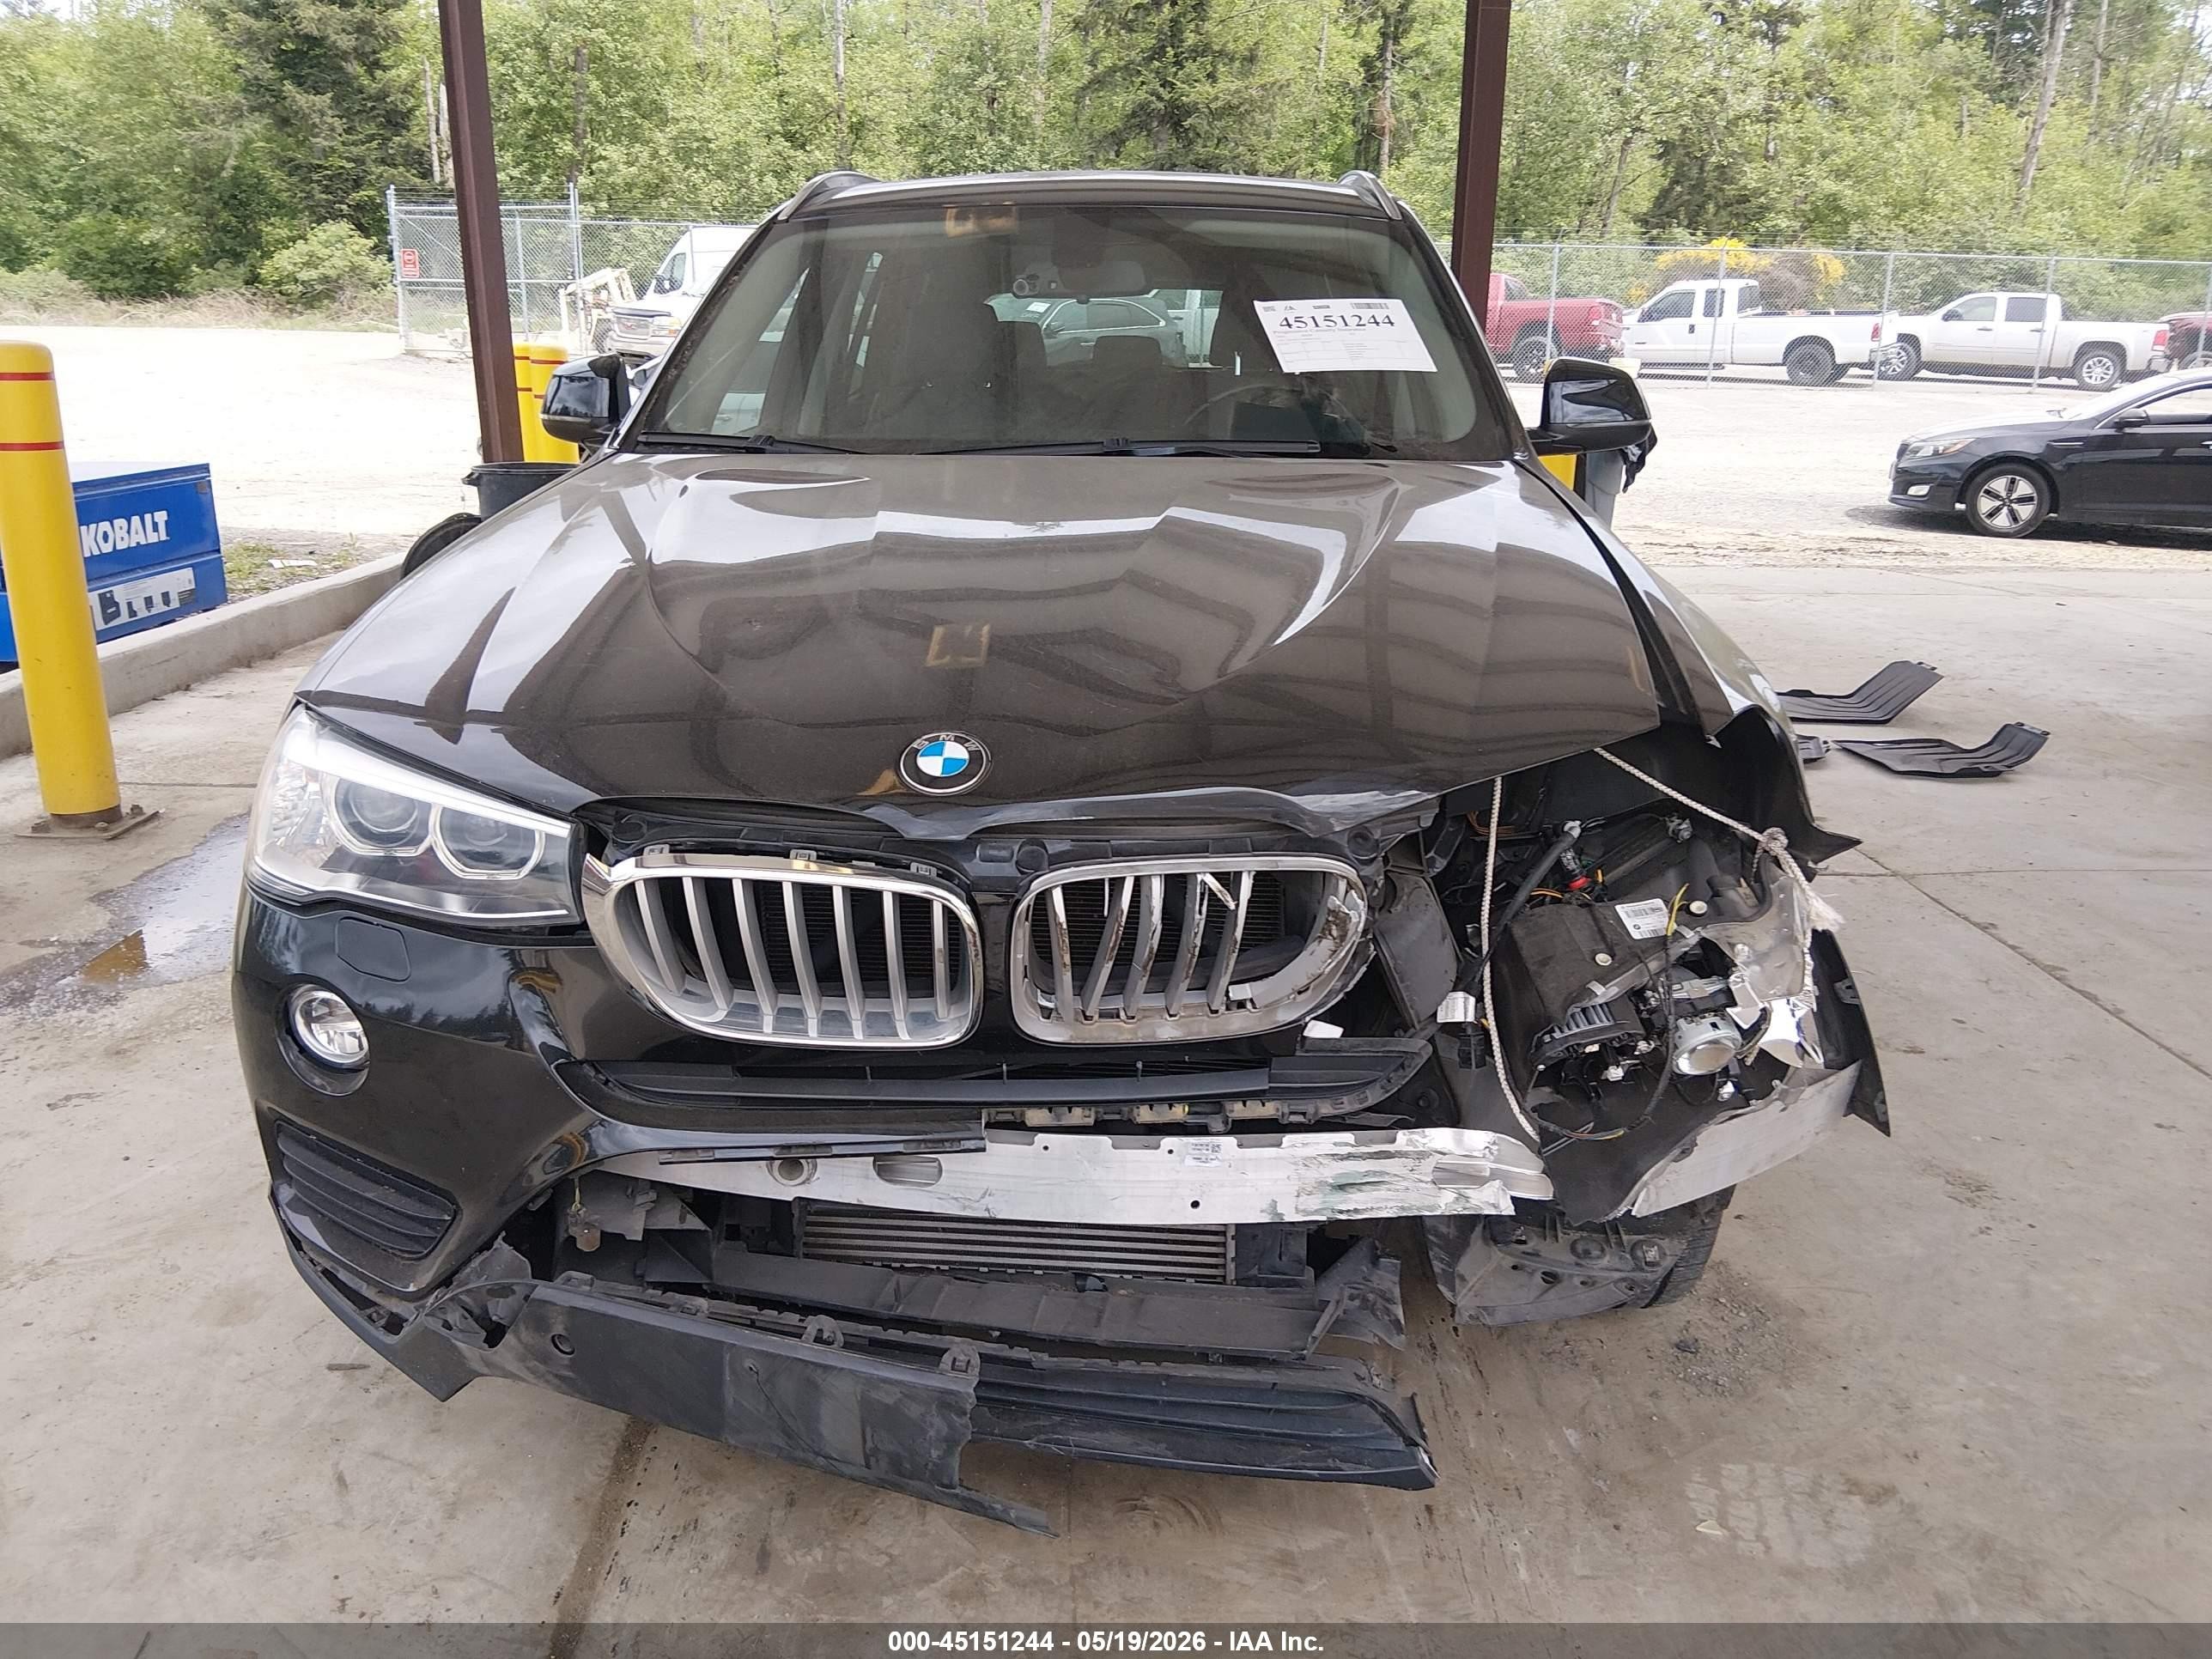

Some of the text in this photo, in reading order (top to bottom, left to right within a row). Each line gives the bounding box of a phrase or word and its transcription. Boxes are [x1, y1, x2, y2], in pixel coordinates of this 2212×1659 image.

[1279, 314, 1395, 329] 45151244
[80, 510, 168, 557] KOBALT
[912, 734, 981, 751] BMW
